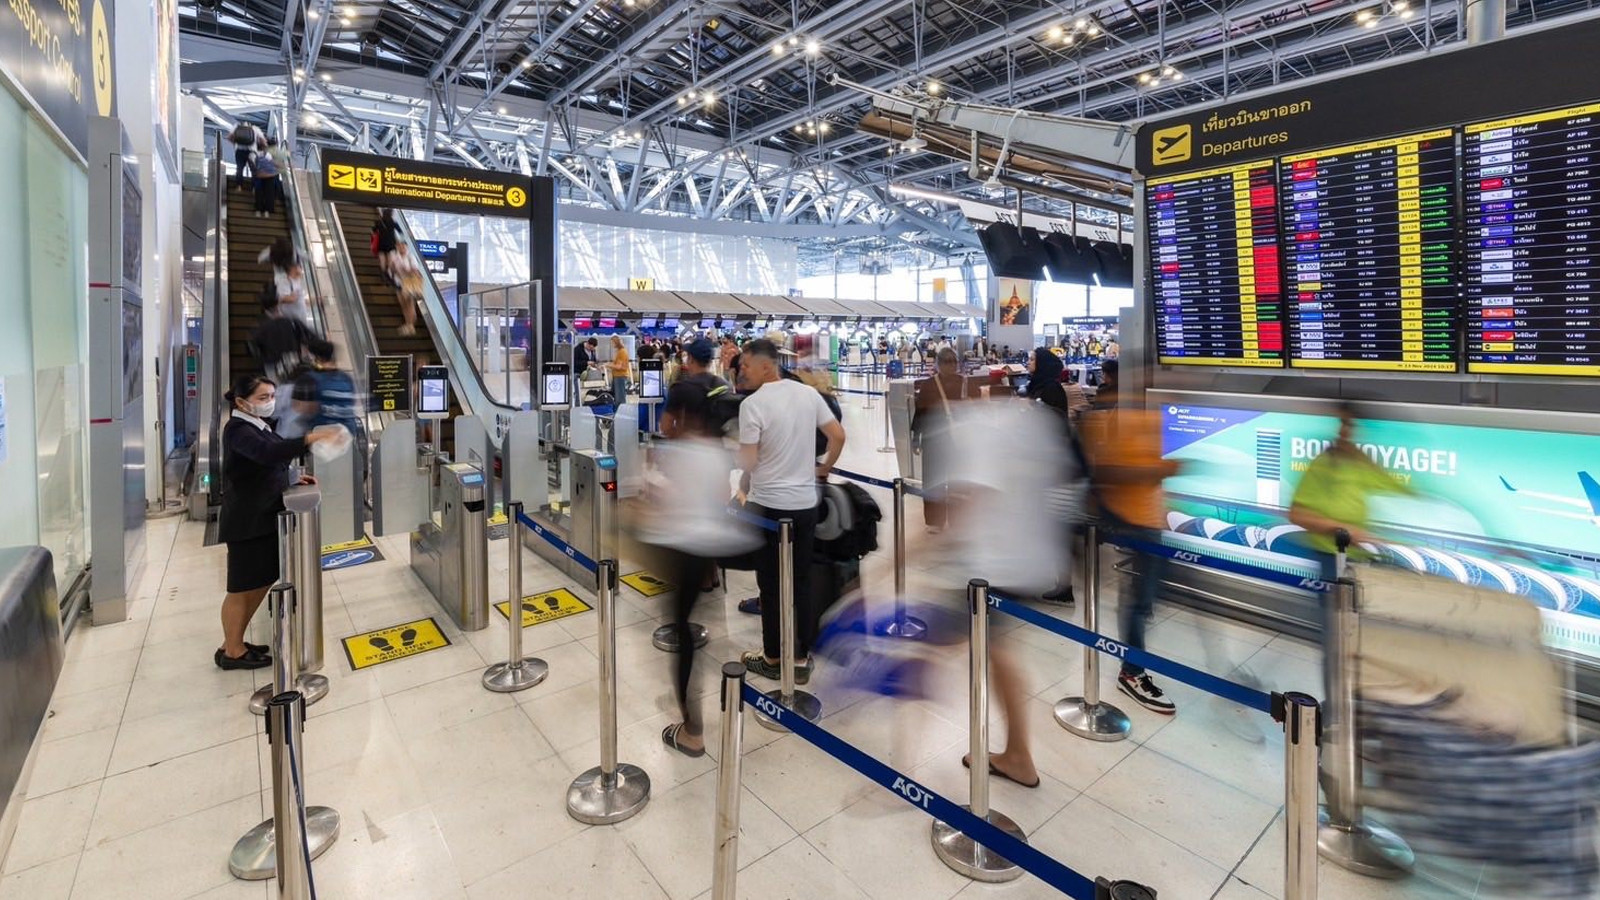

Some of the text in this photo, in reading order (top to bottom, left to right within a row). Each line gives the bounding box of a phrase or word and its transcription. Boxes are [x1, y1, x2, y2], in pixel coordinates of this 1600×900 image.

[97, 29, 106, 90] 3
[1202, 100, 1311, 133] เที่ยวบินขาออก
[1202, 131, 1289, 157] Departures
[384, 186, 476, 203] International Departures
[512, 191, 521, 204] 3
[636, 280, 647, 290] W
[1355, 443, 1457, 477] OYAGE!
[1173, 550, 1202, 564] AOT
[1298, 577, 1332, 595] AOT
[988, 594, 1003, 608] OT
[368, 625, 410, 639] PLEASE
[366, 647, 403, 662] STAND
[405, 640, 434, 650] HERE
[1094, 637, 1129, 659] AOT
[755, 696, 786, 721] AOT
[892, 776, 935, 809] AOT
